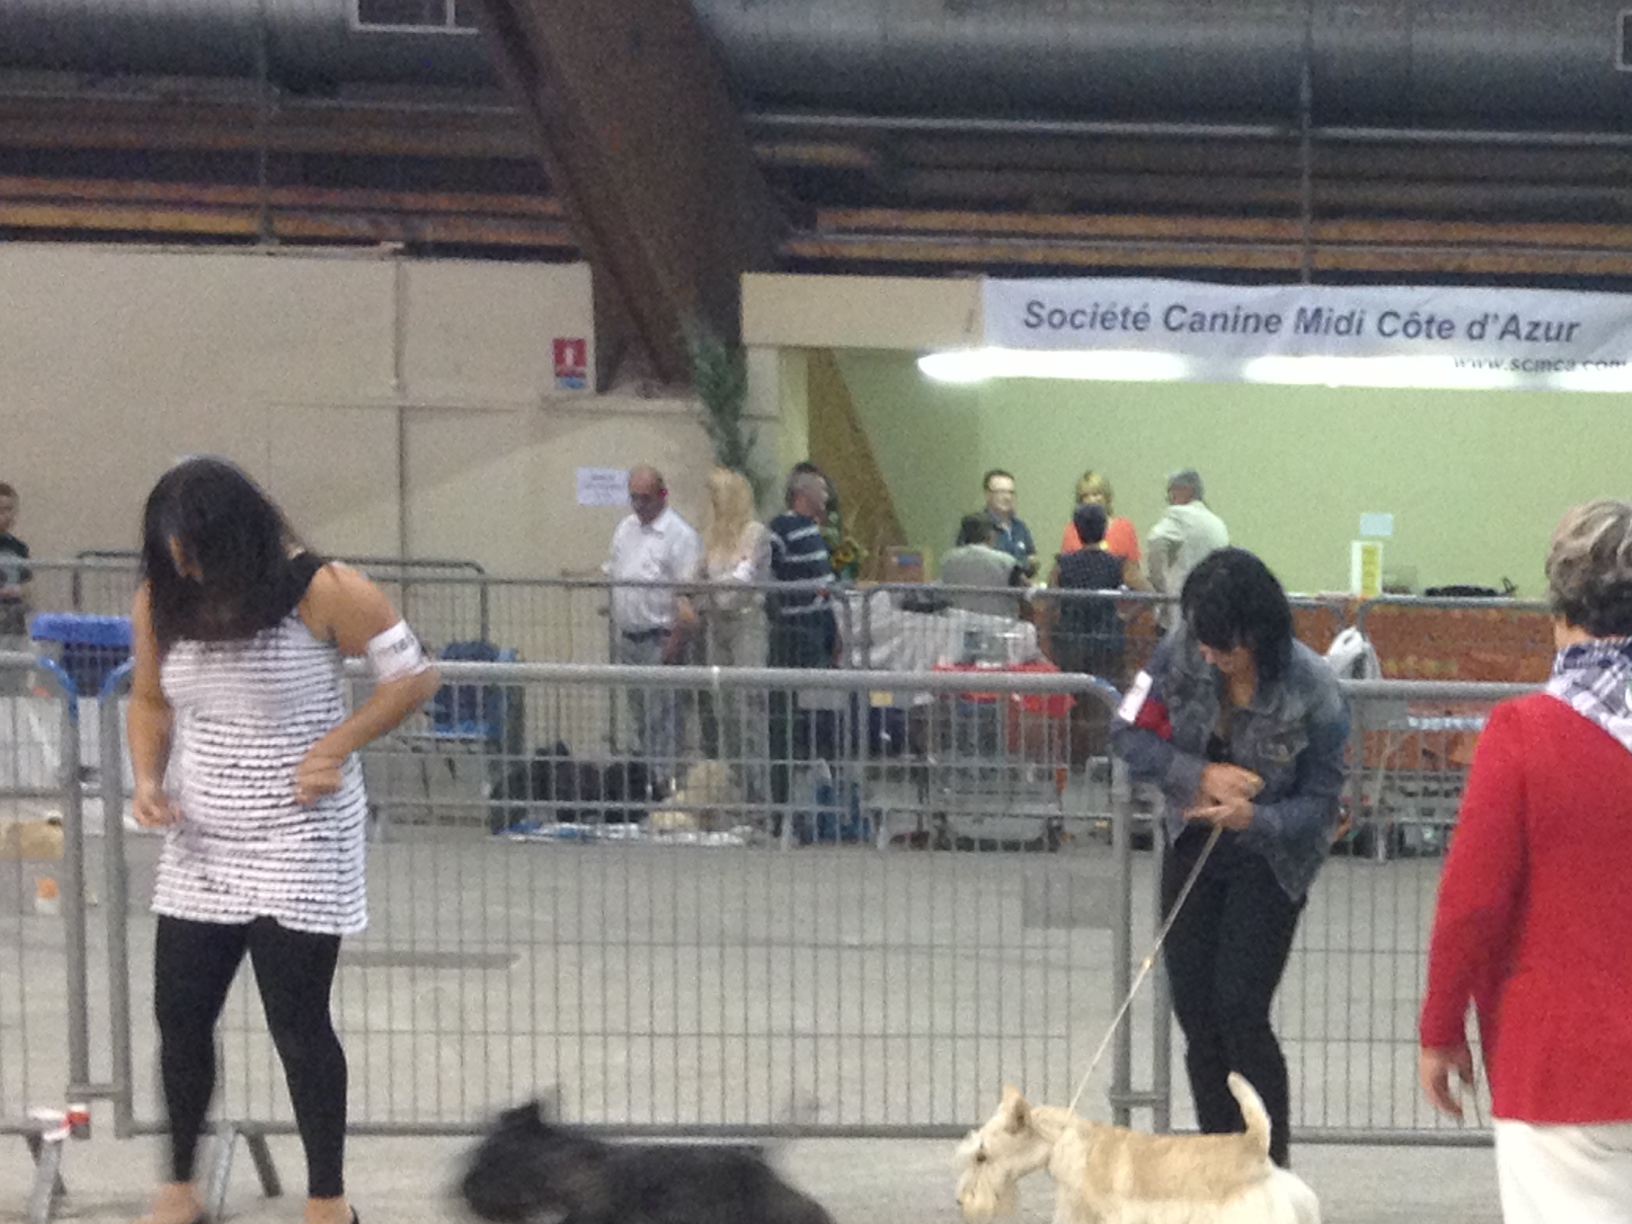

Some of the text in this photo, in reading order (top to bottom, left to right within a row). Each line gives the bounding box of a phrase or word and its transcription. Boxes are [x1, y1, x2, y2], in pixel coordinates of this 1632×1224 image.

[1023, 299, 1581, 344] Société Canine Midi Côte d'Azur
